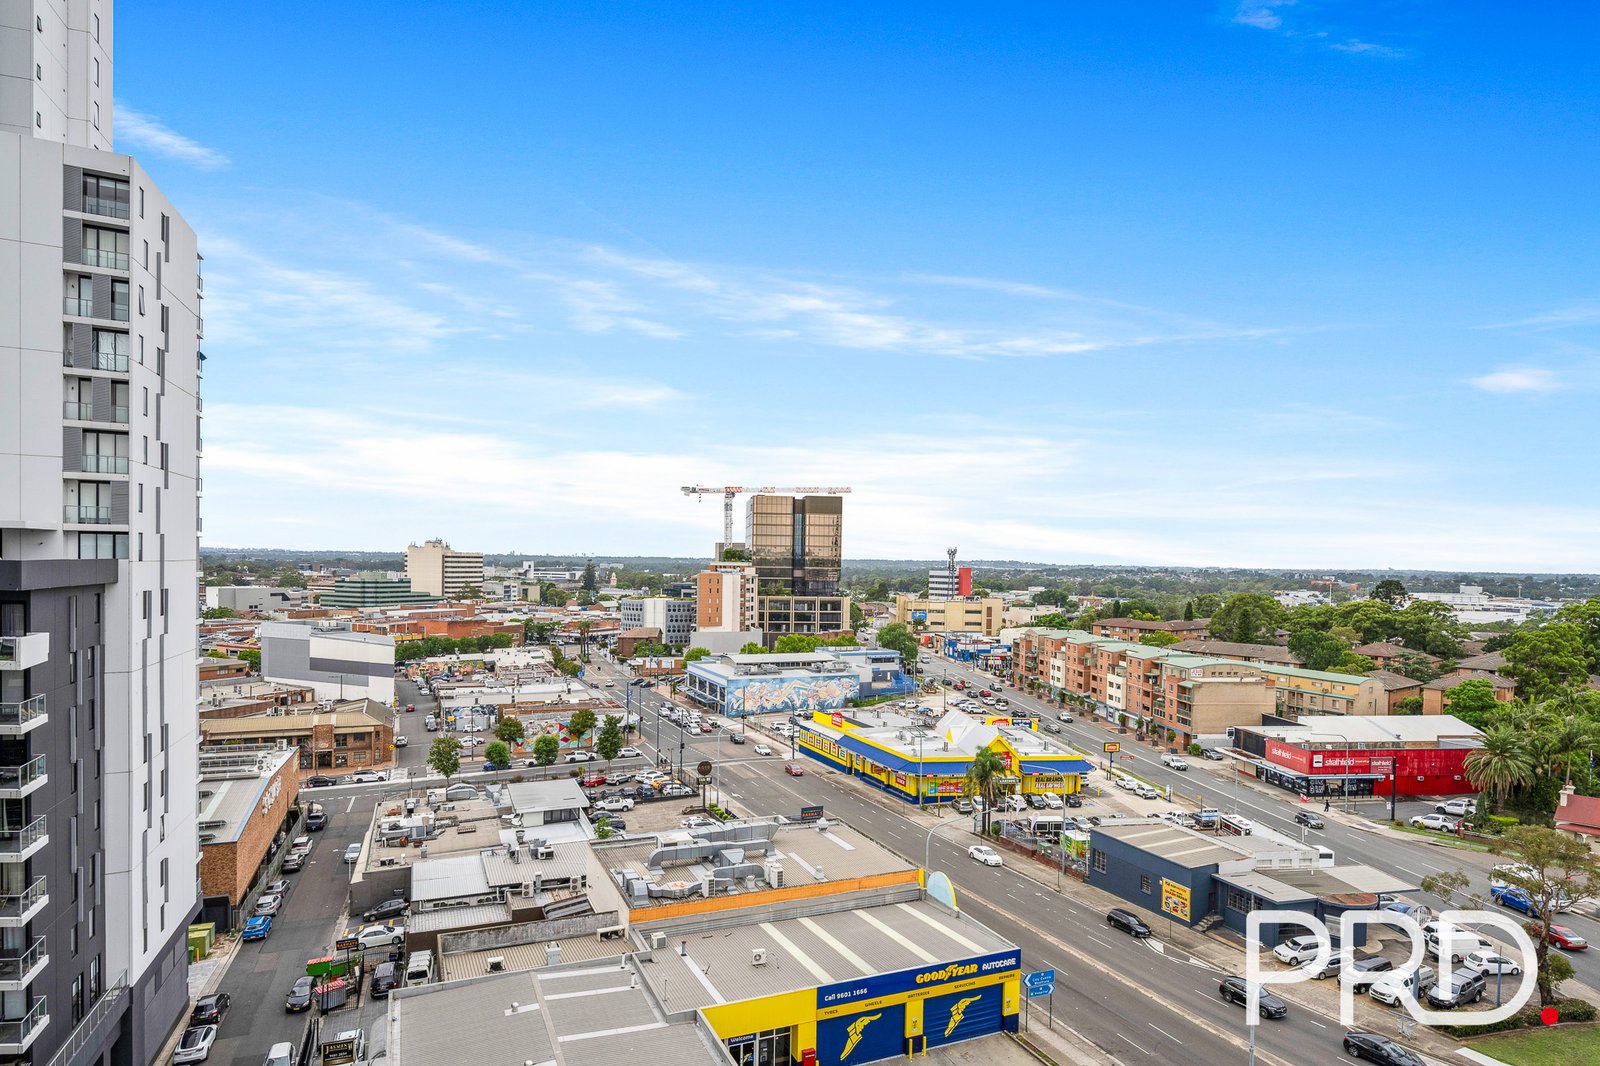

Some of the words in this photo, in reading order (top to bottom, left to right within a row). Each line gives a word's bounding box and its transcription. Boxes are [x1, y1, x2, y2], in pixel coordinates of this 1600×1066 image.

[981, 957, 1017, 971] AUTOCARE
[954, 981, 976, 989] SERVICING
[824, 993, 836, 1002] Call
[907, 990, 930, 999] BATTERIES
